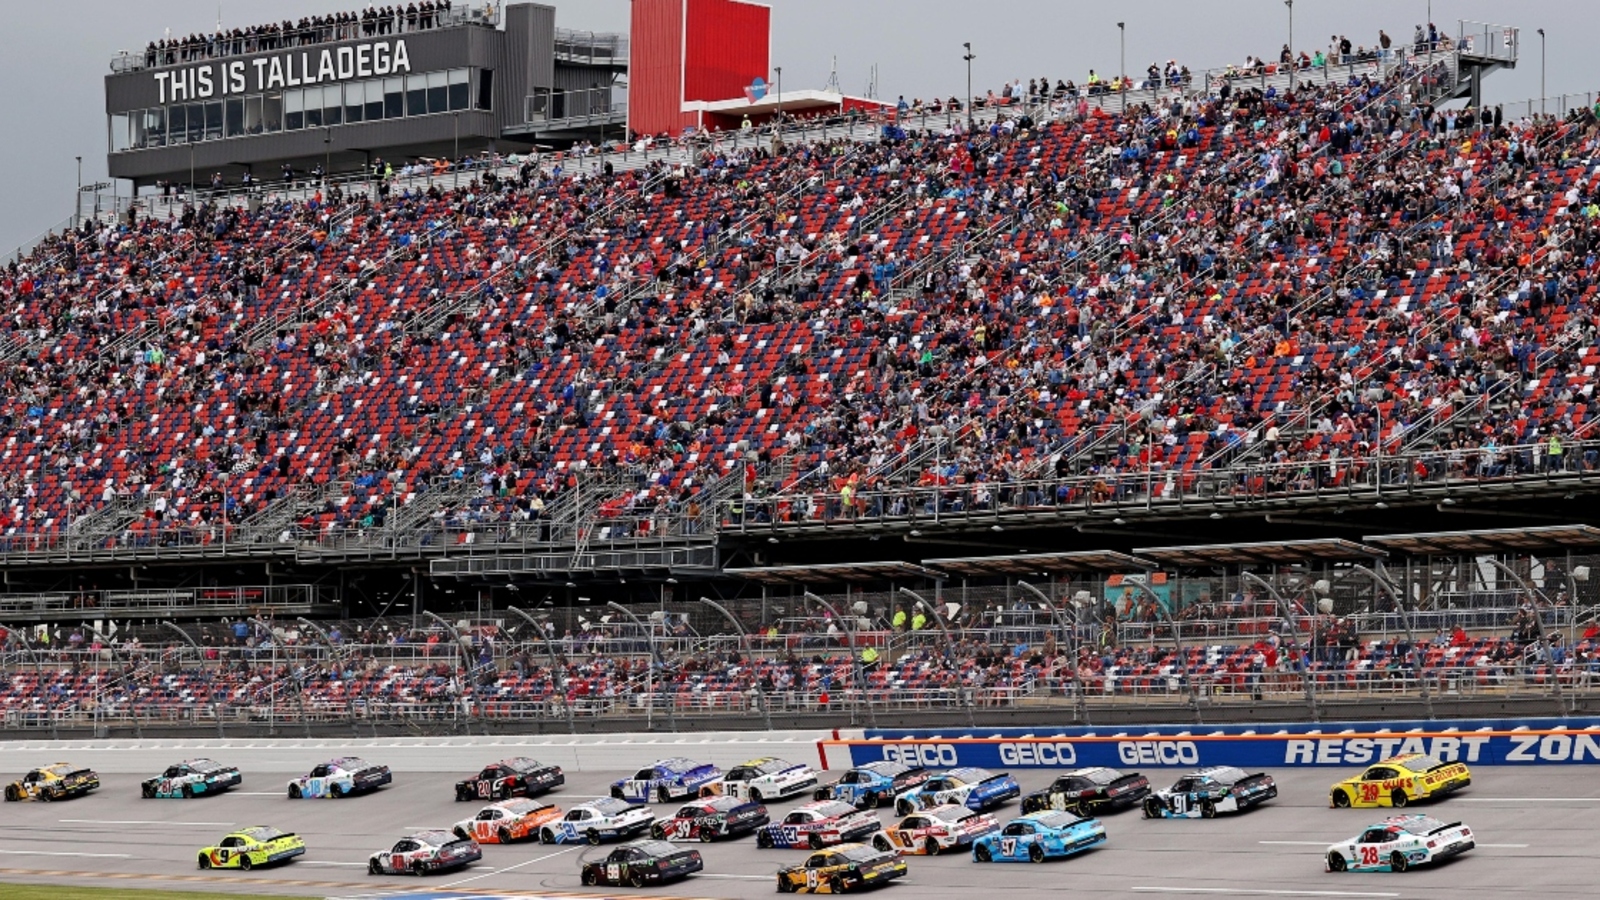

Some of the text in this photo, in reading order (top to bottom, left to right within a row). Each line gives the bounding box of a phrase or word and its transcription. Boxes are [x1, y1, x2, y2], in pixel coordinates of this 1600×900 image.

[154, 39, 411, 104] THIS IS TALLADEGA
[882, 741, 1199, 767] GEICO GEICO GEICO
[1284, 732, 1600, 763] RESTART ZON
[310, 779, 321, 794] 18
[478, 780, 490, 797] 20
[726, 783, 738, 798] 16
[1382, 777, 1413, 790] OLLIE'S
[841, 786, 854, 803] 51
[1361, 784, 1379, 801] 29
[1174, 795, 1187, 814] 91
[563, 823, 579, 840] 21
[675, 820, 691, 838] 39
[782, 826, 798, 843] 27
[899, 831, 914, 848] 8
[1002, 838, 1016, 857] 97
[220, 850, 229, 864] 9
[1360, 846, 1378, 866] 28
[806, 870, 818, 888] 19
